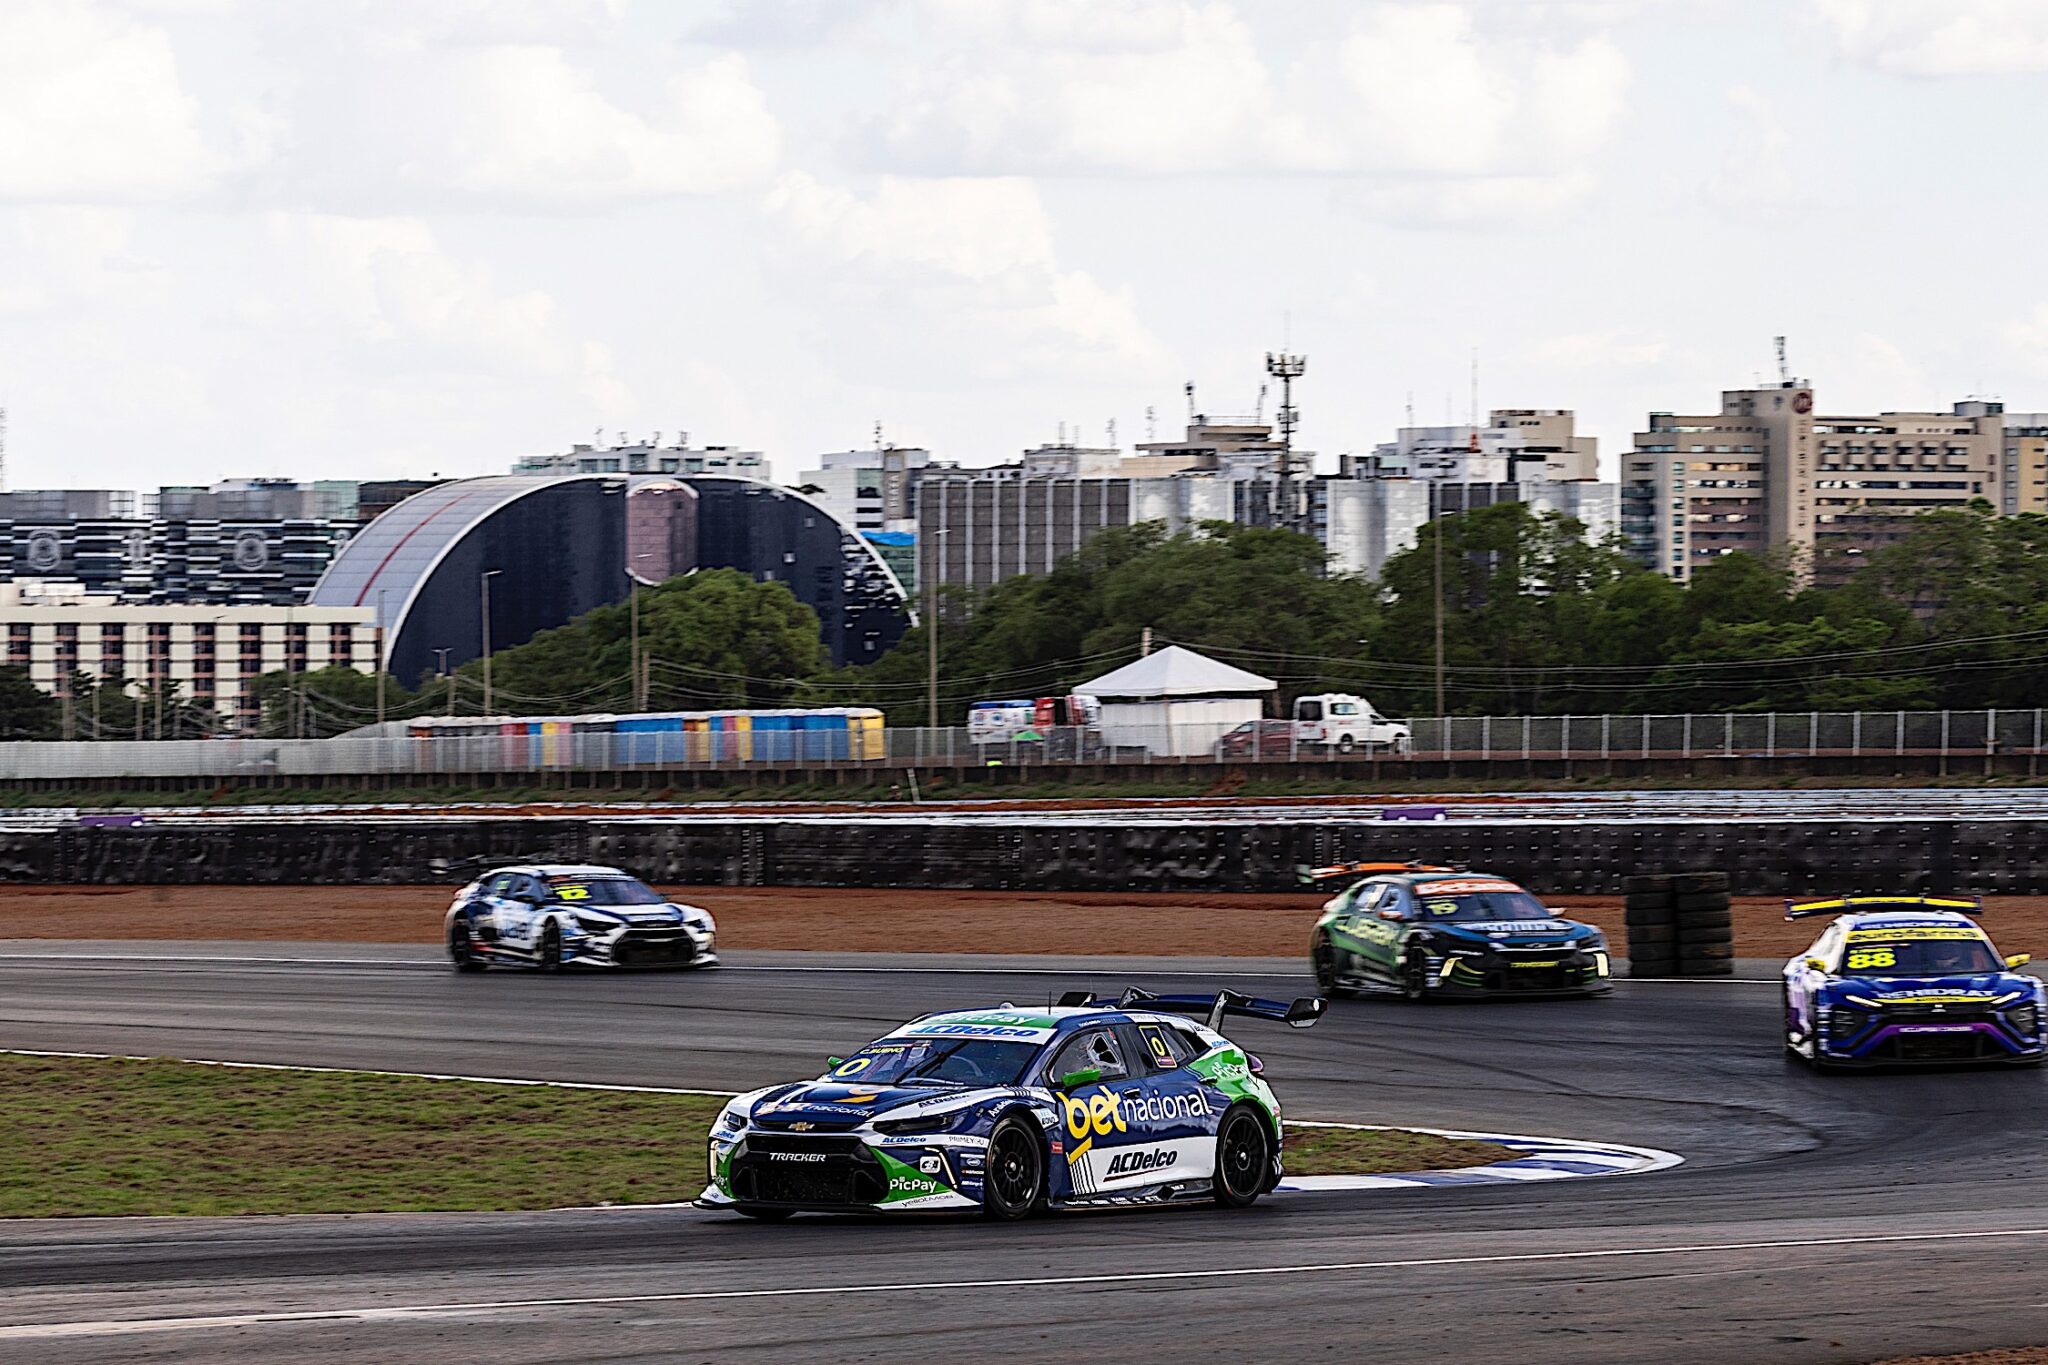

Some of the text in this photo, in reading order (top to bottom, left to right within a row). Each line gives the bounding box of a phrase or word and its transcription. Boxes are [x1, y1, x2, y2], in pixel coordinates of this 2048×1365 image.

[1847, 952, 1897, 969] 88
[907, 1024, 1040, 1037] ACDelco
[1151, 1036, 1165, 1056] 0
[834, 1057, 872, 1077] 0
[769, 1152, 827, 1162] TRACKER
[1107, 1148, 1178, 1175] ACDelco
[889, 1177, 937, 1193] PicPay
